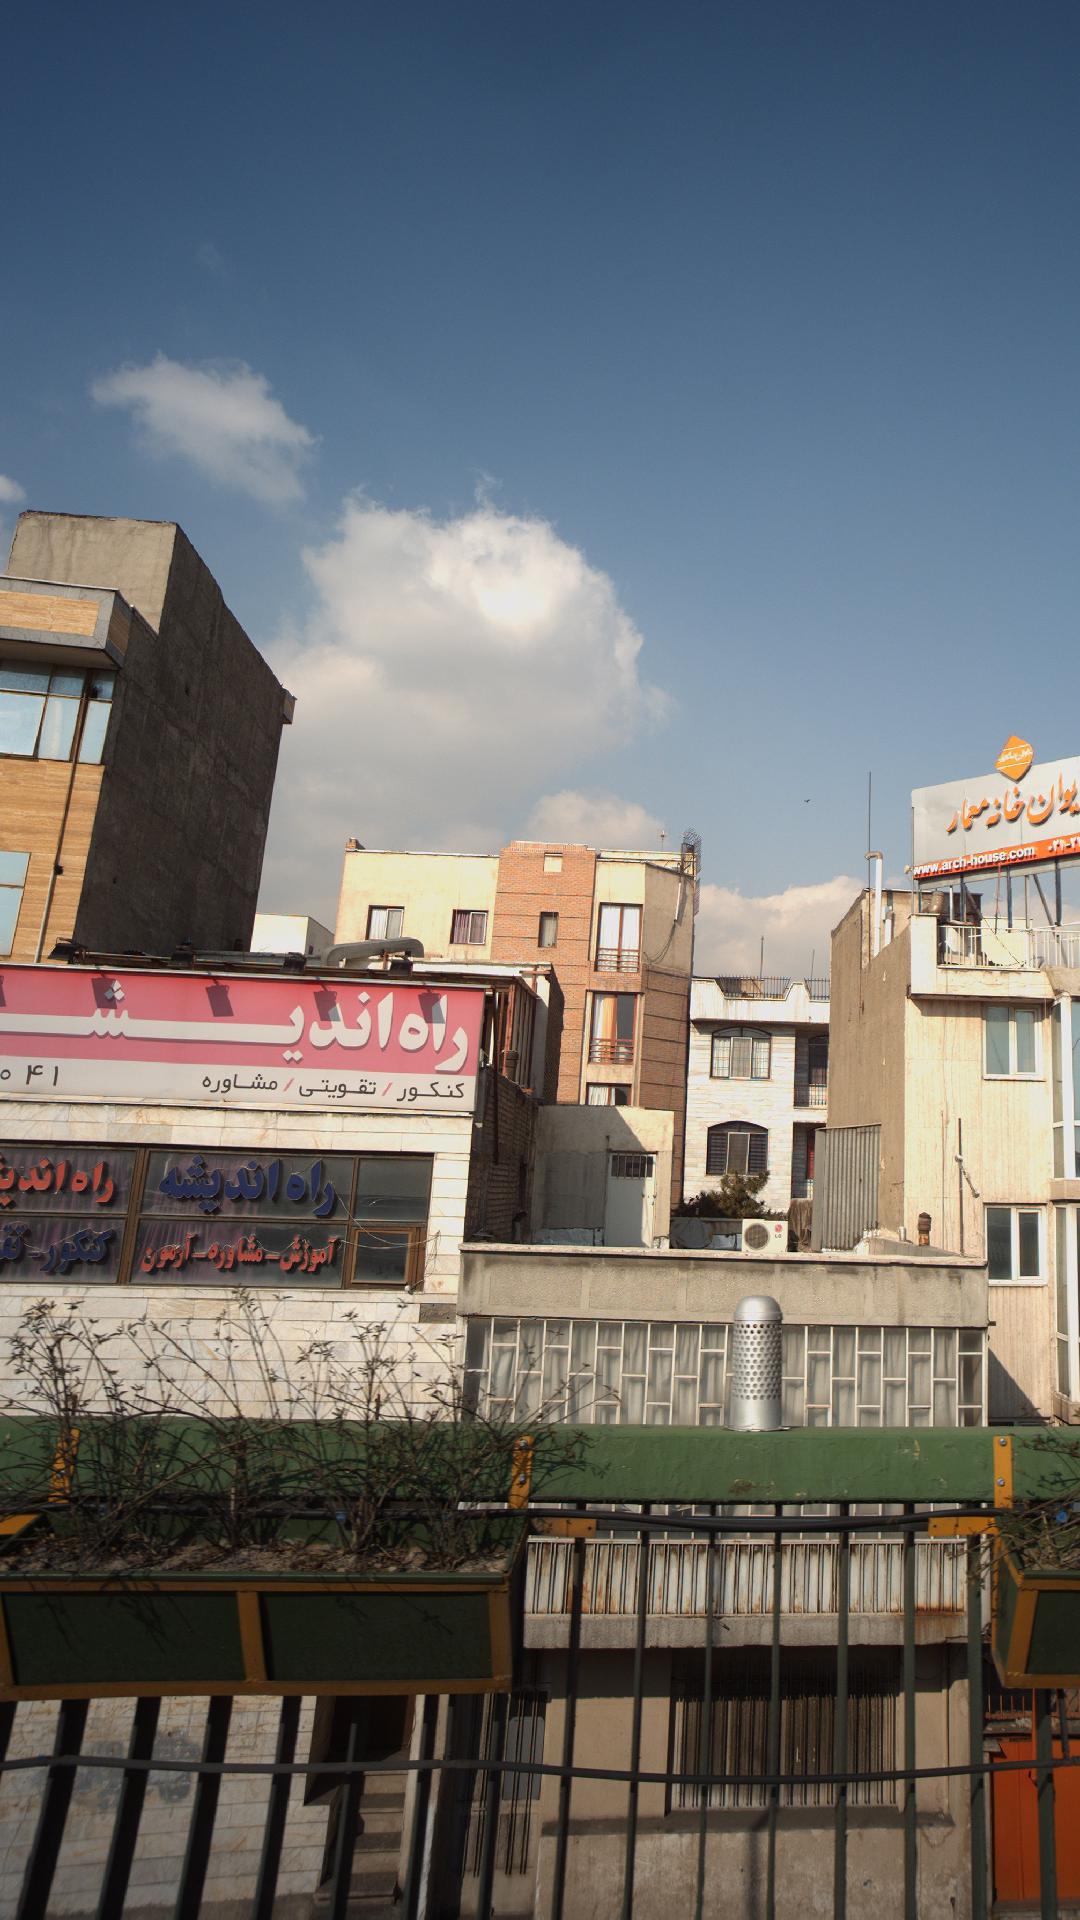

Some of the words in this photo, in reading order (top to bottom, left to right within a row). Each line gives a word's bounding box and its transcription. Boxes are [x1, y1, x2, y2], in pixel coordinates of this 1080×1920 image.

[944, 798, 989, 833] معمار
[986, 786, 1024, 827] خانه
[913, 846, 1035, 875] www.arch-house.com
[398, 993, 469, 1072] راه
[202, 1073, 278, 1094] مشاوره
[299, 1078, 377, 1099] تقویتی
[397, 1081, 465, 1102] کنکور
[71, 1160, 114, 1203] راه
[159, 1155, 281, 1213] اندیشه
[287, 1160, 335, 1216] راه
[208, 1234, 263, 1269] مشاوره
[279, 1234, 338, 1273] آموزش
